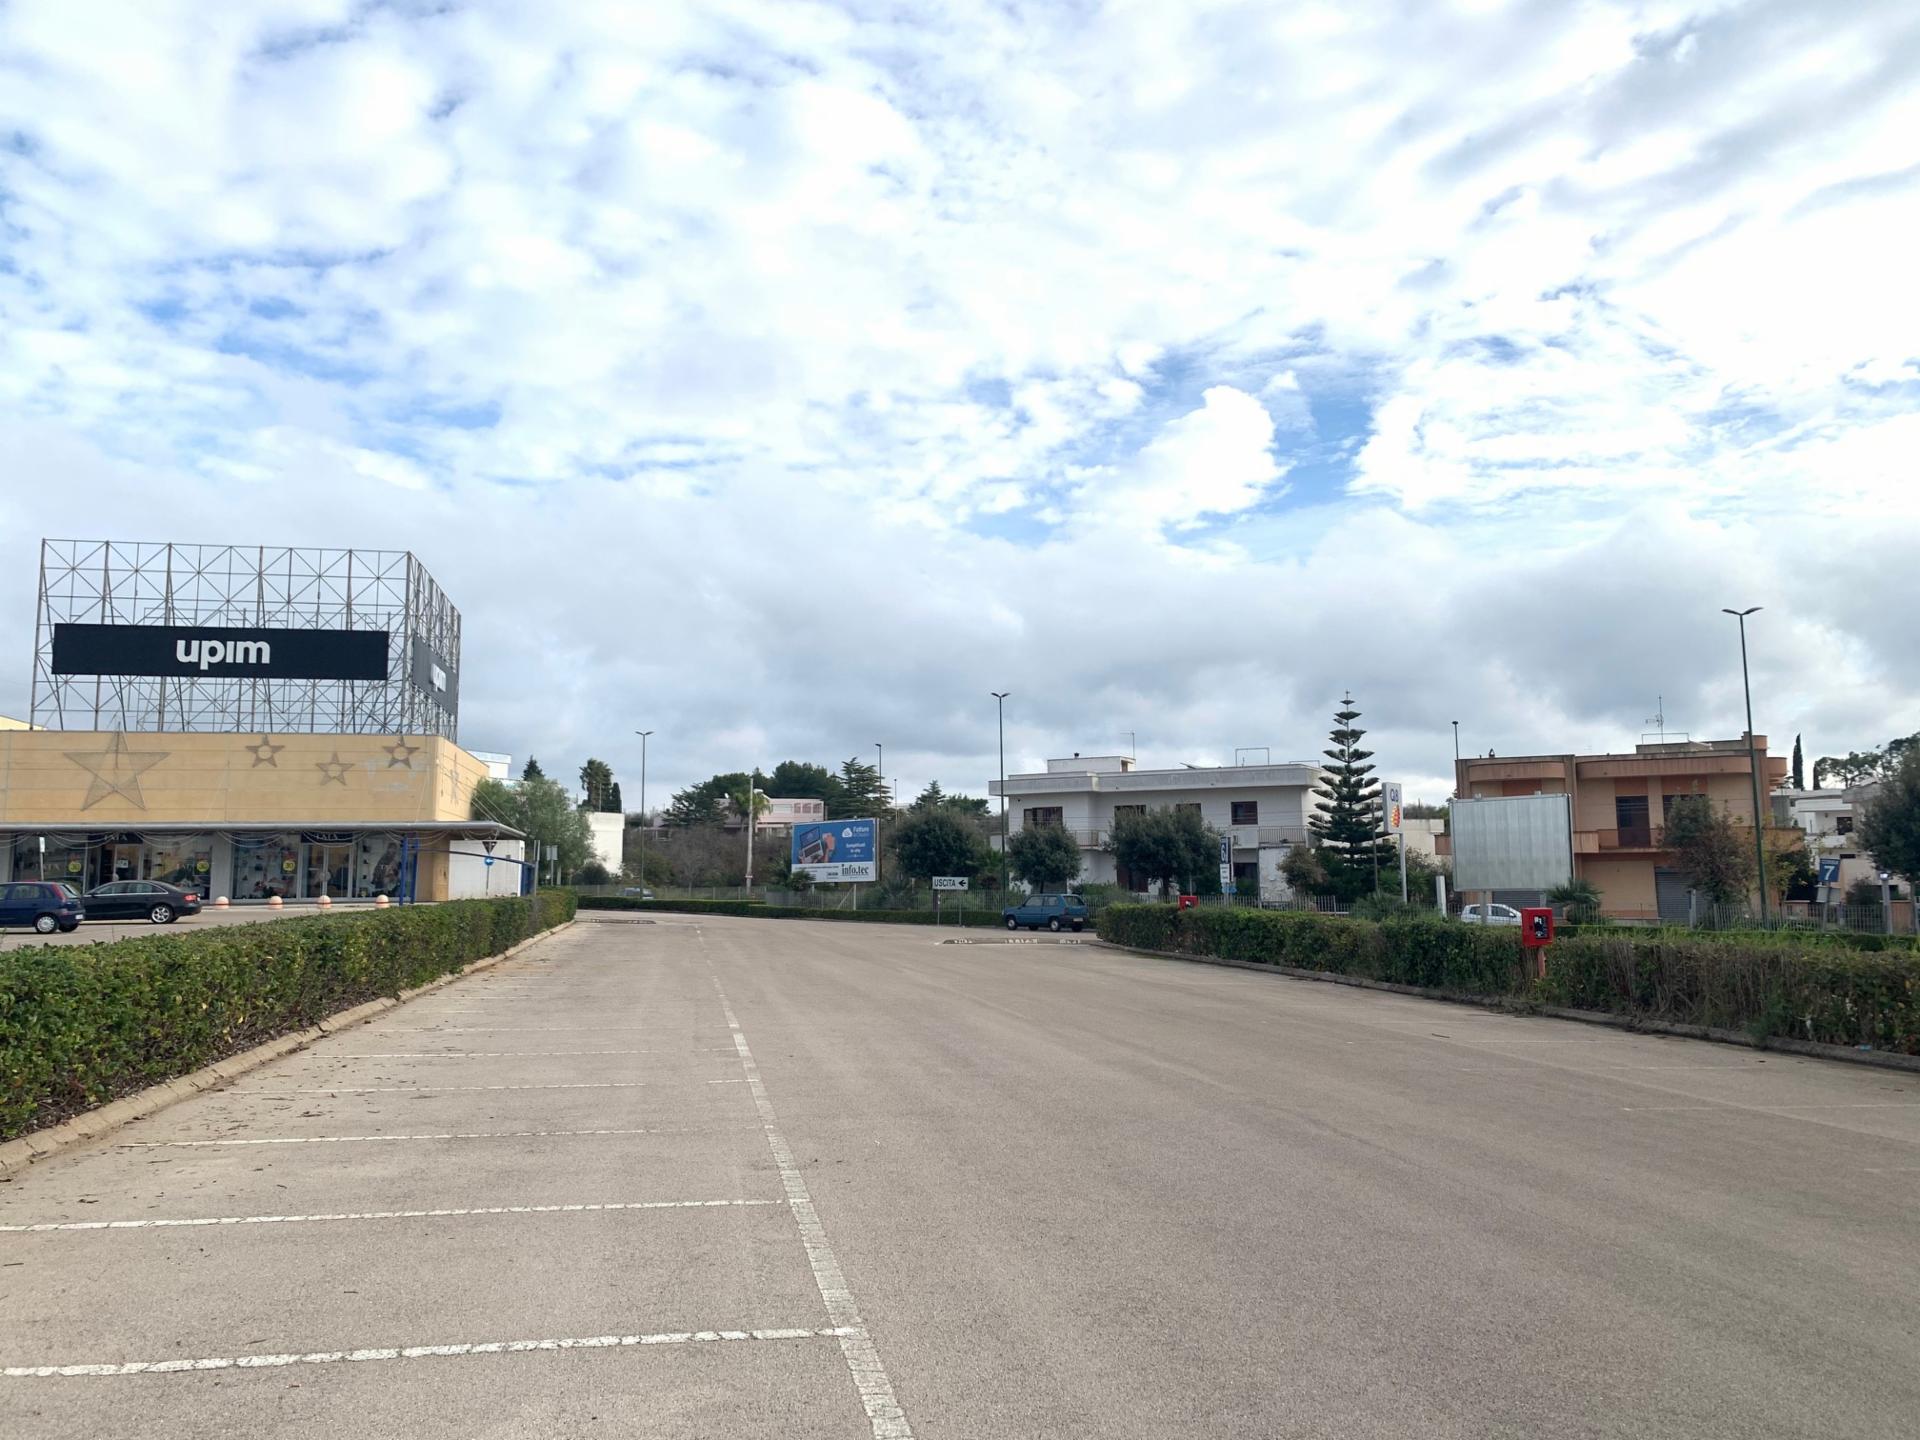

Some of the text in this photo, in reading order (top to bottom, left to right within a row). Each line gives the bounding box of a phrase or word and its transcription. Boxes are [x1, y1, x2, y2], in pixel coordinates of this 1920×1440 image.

[176, 639, 271, 671] upim
[1824, 865, 1836, 881] 7
[934, 879, 956, 887] USCITA
